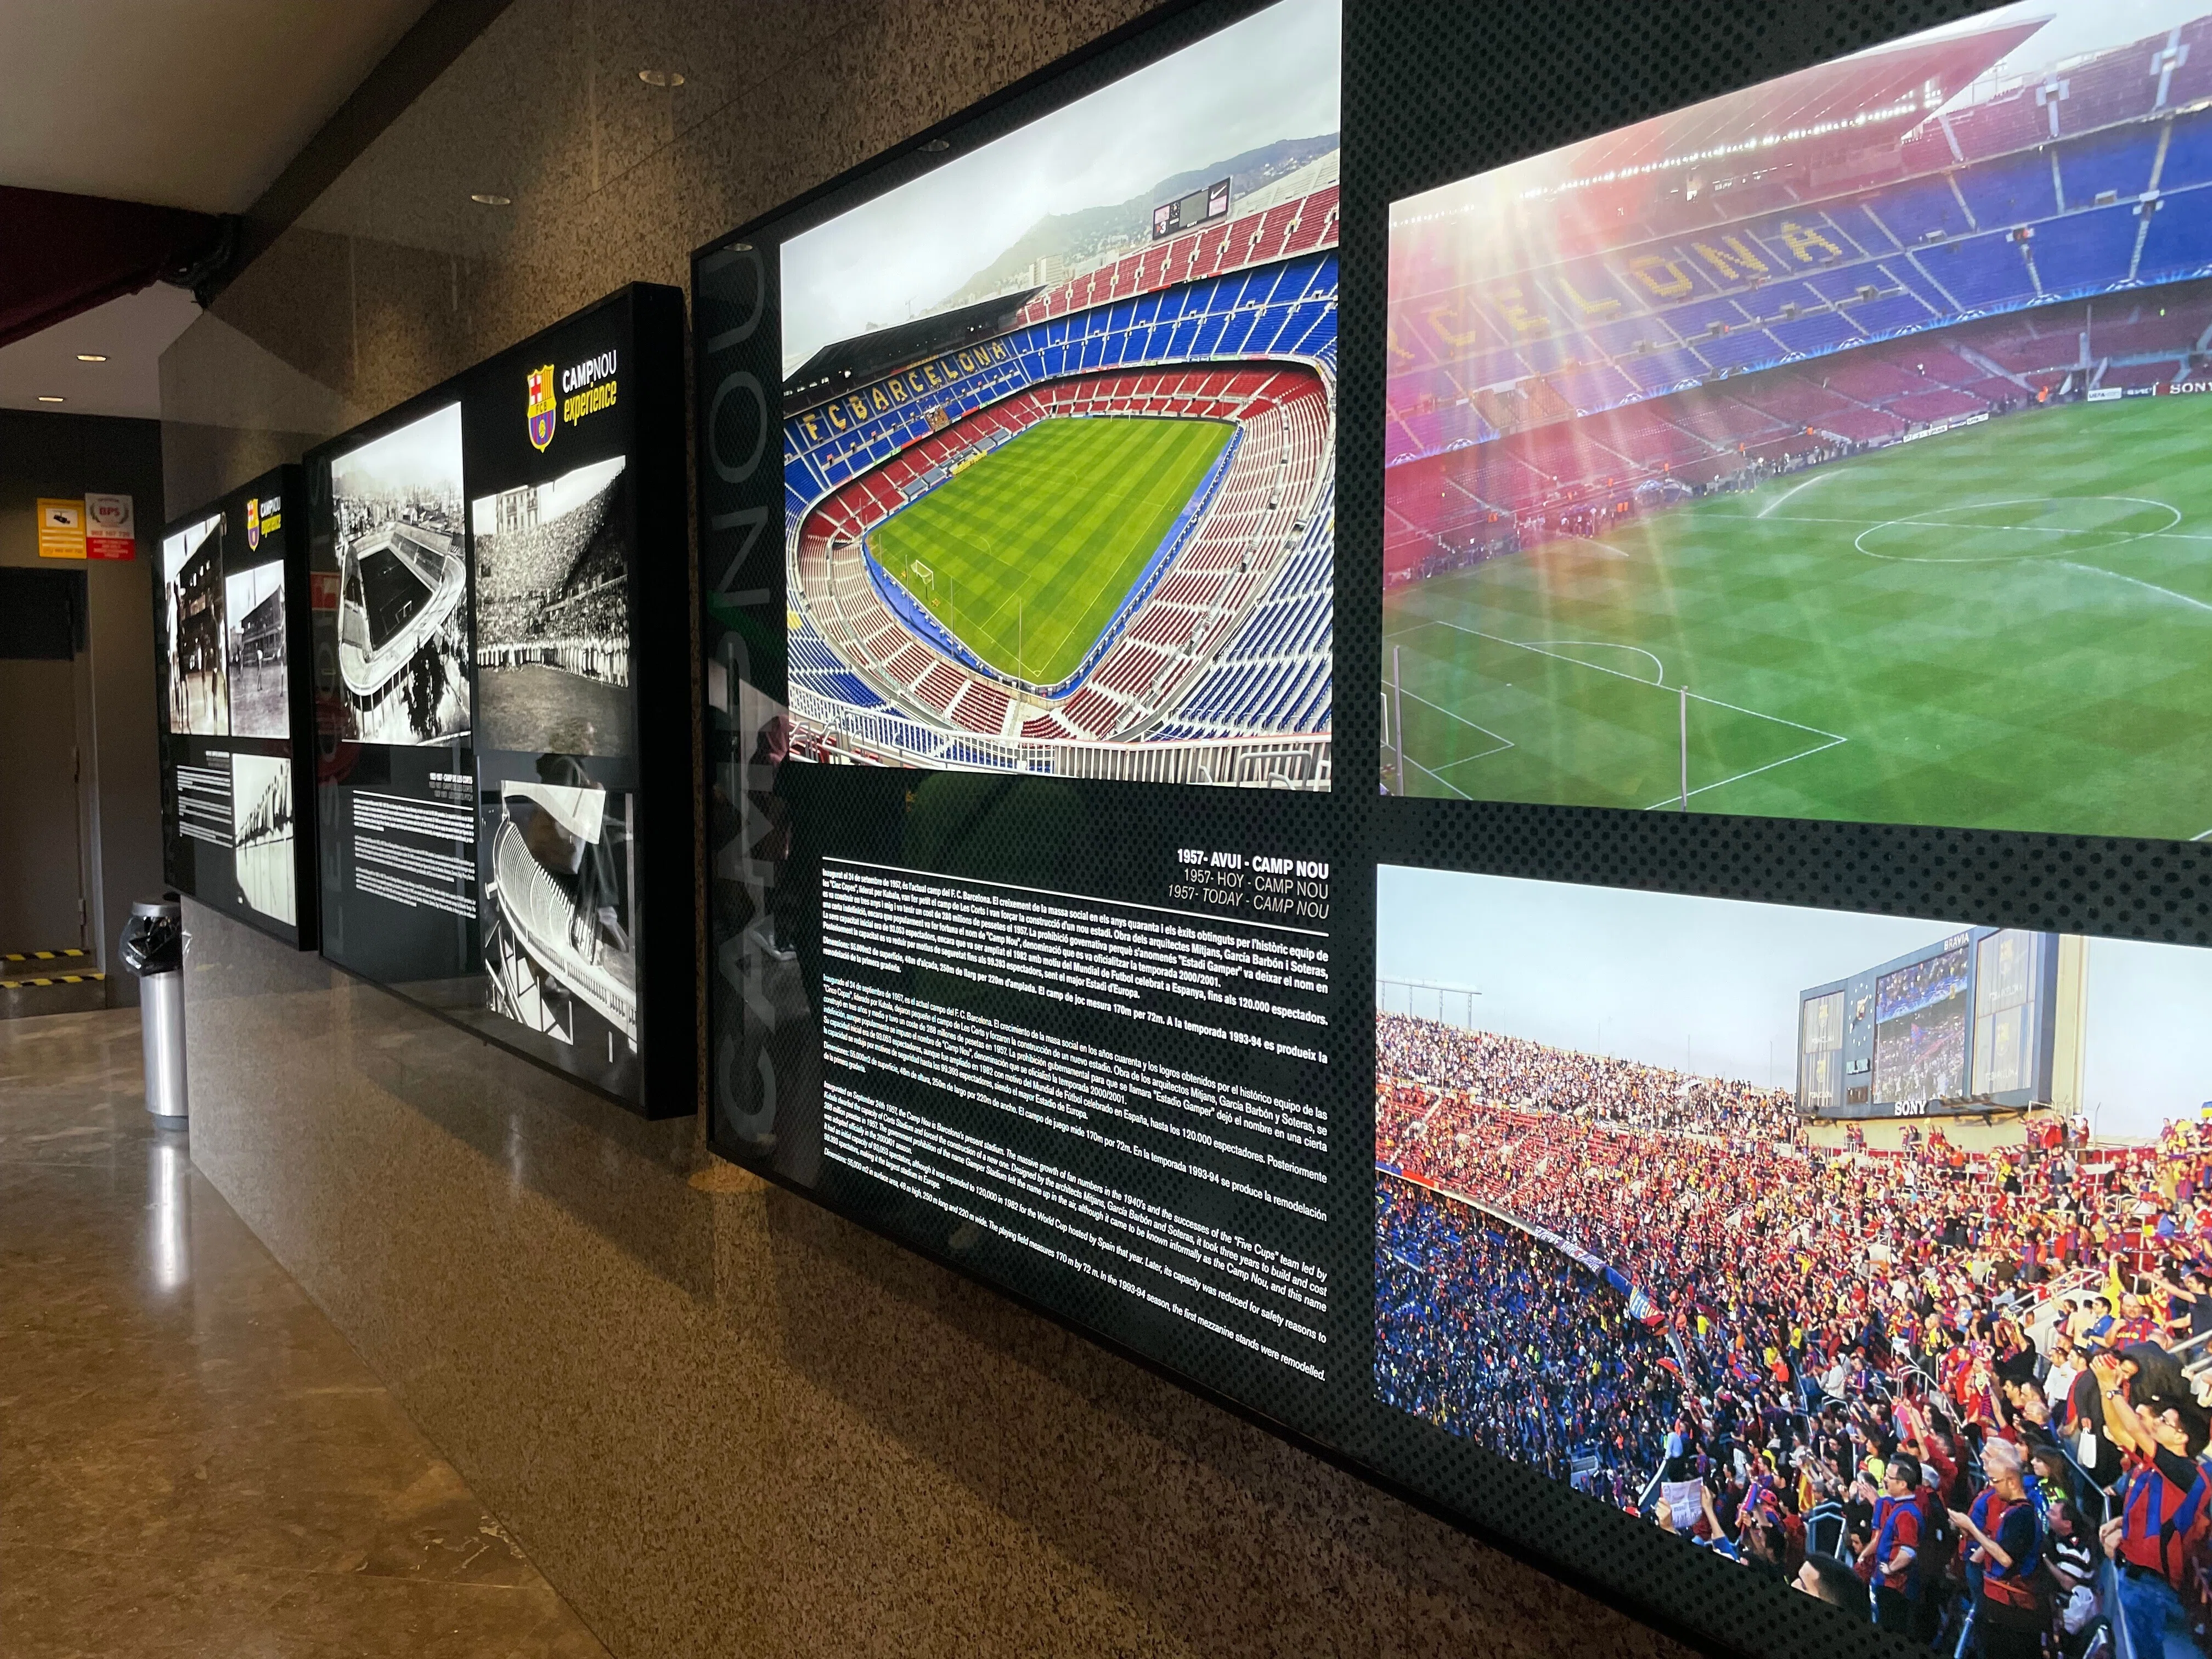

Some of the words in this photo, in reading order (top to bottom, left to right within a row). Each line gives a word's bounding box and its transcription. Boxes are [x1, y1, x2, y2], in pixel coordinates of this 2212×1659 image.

[563, 349, 617, 393] CAMPNOU
[535, 401, 548, 415] FCB
[564, 380, 617, 426] experience
[1177, 849, 1208, 865] 1957-
[1210, 851, 1242, 870] AVUI
[1252, 856, 1294, 874] CAMP
[1296, 860, 1329, 879] NOU
[1184, 867, 1214, 884] 1957-
[1217, 871, 1244, 888] HOY
[1255, 876, 1294, 894] CAMP
[1297, 881, 1328, 899] NOU
[1169, 884, 1199, 900] 1957-
[1203, 888, 1243, 906] TODAY
[1254, 895, 1294, 913] CAMP
[1296, 900, 1329, 919] NOU
[1177, 926, 1196, 939] èxits
[1197, 930, 1235, 946] obtinguts
[1236, 938, 1251, 949] per
[1289, 946, 1315, 962] equip
[1316, 950, 1329, 962] de
[1944, 932, 1970, 951] BRAVIA
[856, 954, 862, 963] la
[861, 956, 880, 968] primera
[879, 962, 901, 973] graderia.
[1084, 952, 1093, 962] va
[1093, 953, 1130, 969] oficialitzar
[1130, 960, 1138, 971] la
[1138, 961, 1178, 979] temporada
[1178, 969, 1221, 988] 2000/2001.
[1191, 943, 1223, 961] Mitjans,
[1223, 949, 1251, 964] García
[1252, 953, 1284, 970] Barbón
[1285, 960, 1289, 971] i
[1290, 960, 1328, 980] Soteras,
[1044, 970, 1058, 981] sent
[1058, 972, 1065, 983] el
[1066, 975, 1086, 987] major
[1086, 977, 1107, 991] Estadi
[1243, 969, 1254, 979] va
[1255, 969, 1283, 985] deixar
[1283, 975, 1293, 987] el
[1294, 979, 1314, 991] nom
[1316, 983, 1328, 994] en
[1172, 982, 1206, 1001] Espanya,
[1207, 989, 1223, 1003] fins
[1224, 994, 1237, 1006] als
[1238, 996, 1270, 1013] 120.000
[1271, 1005, 1328, 1026] espectadors.
[1175, 1017, 1182, 1029] la
[1183, 1020, 1227, 1040] temporada
[1229, 1030, 1262, 1048] 1993-94
[1263, 1040, 1275, 1051] es
[1277, 1043, 1317, 1061] produeix
[1318, 1051, 1328, 1064] la
[1035, 1093, 1057, 1109] Estadio
[1057, 1101, 1065, 1112] de
[1065, 1103, 1088, 1120] Europa.
[1058, 1076, 1090, 1093] temporada
[1090, 1085, 1127, 1105] 2000/2001.
[1181, 1071, 1216, 1089] obtenidos
[1217, 1082, 1231, 1093] por
[1231, 1085, 1238, 1096] el
[1240, 1086, 1272, 1104] histórico
[1273, 1098, 1301, 1114] equipo
[1302, 1104, 1314, 1116] de
[1315, 1107, 1328, 1120] las
[1894, 1100, 1927, 1116] SONY
[1190, 1086, 1217, 1106] Mitjans,
[1218, 1095, 1244, 1112] García
[1245, 1102, 1274, 1120] Barbón
[1274, 1113, 1280, 1125] y
[1282, 1113, 1315, 1135] Soteras,
[1317, 1126, 1328, 1136] se
[895, 1142, 913, 1155] season.
[1216, 1109, 1233, 1125] dejó
[1234, 1115, 1242, 1126] el
[1243, 1119, 1273, 1135] nombre
[1274, 1128, 1285, 1139] en
[1286, 1132, 1302, 1144] una
[1304, 1136, 1328, 1152] cierta
[1170, 1123, 1181, 1136] los
[1182, 1128, 1212, 1146] 120.000
[1213, 1139, 1266, 1164] espectadores.
[1267, 1154, 1328, 1183] Posteriormente
[923, 1175, 941, 1189] Europe.
[1188, 1165, 1220, 1184] 1993-94
[1221, 1178, 1231, 1188] se
[1232, 1181, 1263, 1199] produce
[1265, 1190, 1272, 1203] la
[1273, 1196, 1327, 1222] remodelación
[1167, 1224, 1195, 1245] Soteras,
[1197, 1235, 1202, 1246] it
[1203, 1239, 1219, 1253] took
[1220, 1245, 1239, 1261] three
[1238, 1255, 1260, 1269] years
[1261, 1262, 1269, 1273] to
[1271, 1265, 1291, 1282] build
[1291, 1276, 1308, 1289] and
[1309, 1283, 1328, 1297] cost
[1173, 1215, 1210, 1235] successes
[1211, 1228, 1220, 1239] of
[1220, 1231, 1232, 1244] the
[1280, 1254, 1300, 1270] team
[1301, 1261, 1316, 1276] led
[1316, 1267, 1328, 1283] by
[1169, 1239, 1203, 1263] informally
[1203, 1255, 1212, 1265] as
[1213, 1257, 1225, 1271] the
[1226, 1262, 1249, 1282] Camp
[1250, 1272, 1269, 1290] Nou,
[1270, 1283, 1286, 1295] and
[1288, 1288, 1302, 1302] this
[1304, 1296, 1327, 1312] name
[1173, 1271, 1201, 1291] capacity
[1202, 1283, 1217, 1296] was
[1217, 1290, 1249, 1310] reduced
[1249, 1301, 1260, 1314] for
[1261, 1309, 1284, 1327] safety
[1285, 1319, 1317, 1339] reasons
[1318, 1331, 1327, 1344] to
[1172, 1303, 1183, 1316] the
[1183, 1307, 1197, 1323] first
[1197, 1316, 1234, 1339] mezzanine
[1235, 1334, 1260, 1351] stands
[1261, 1345, 1280, 1360] were
[1280, 1354, 1325, 1381] remodelled.
